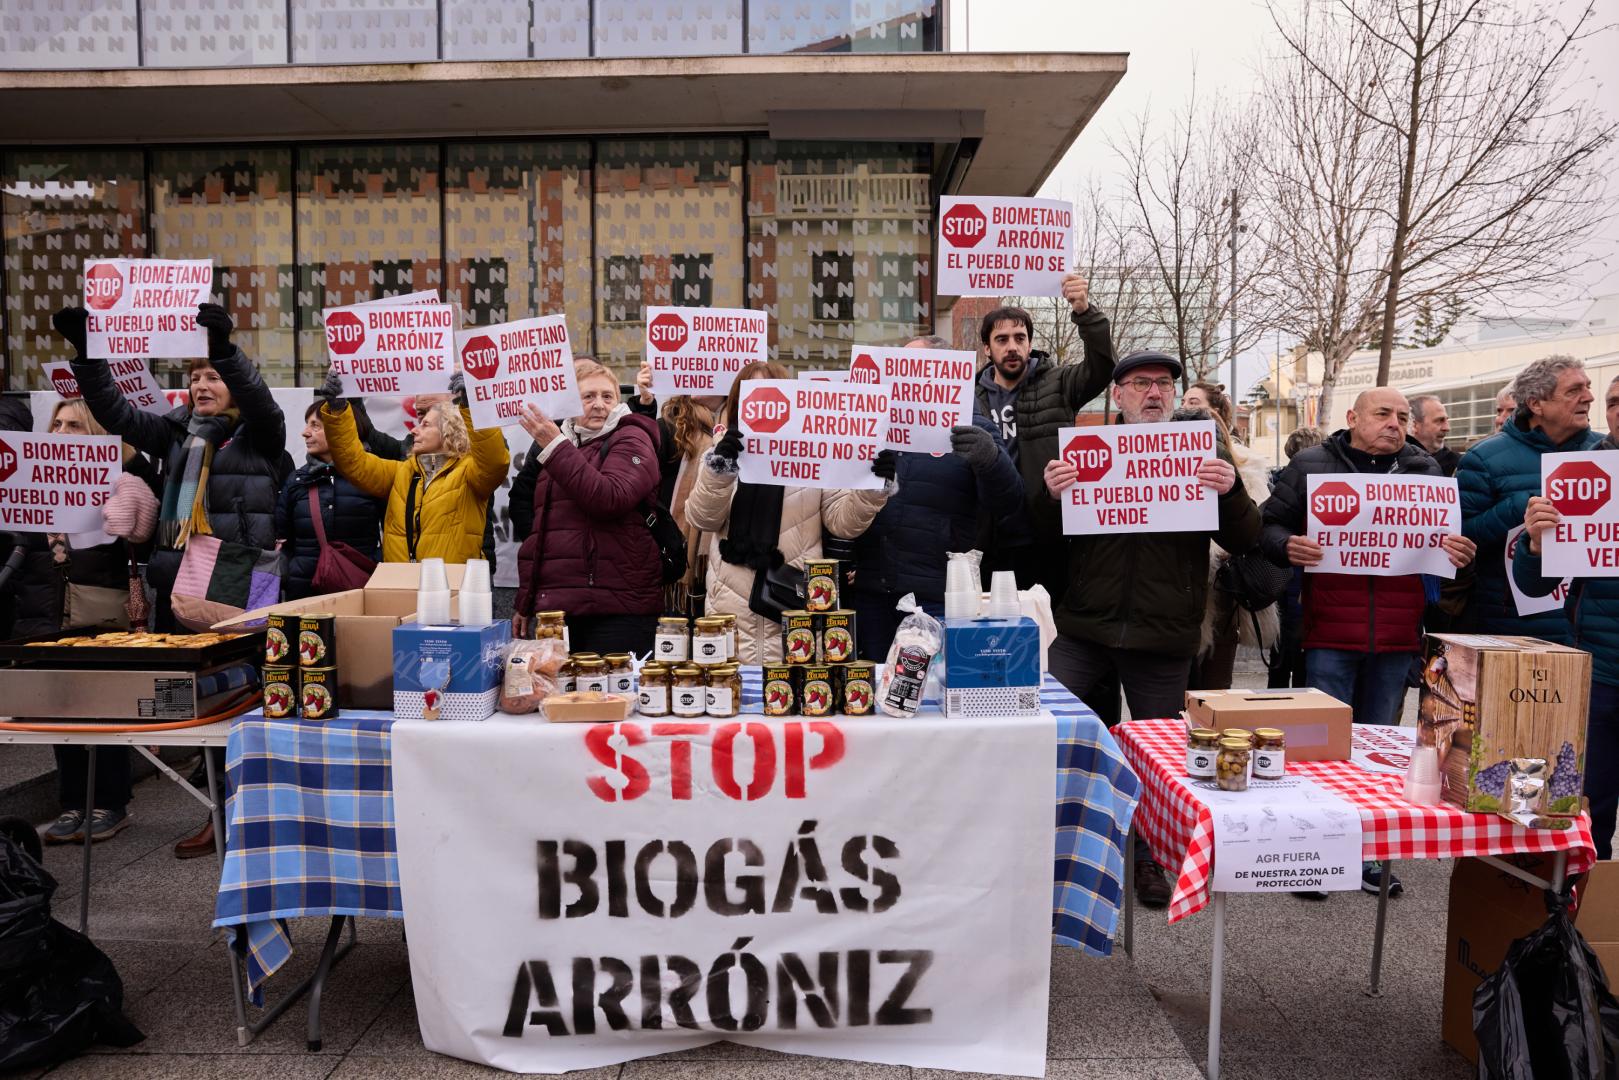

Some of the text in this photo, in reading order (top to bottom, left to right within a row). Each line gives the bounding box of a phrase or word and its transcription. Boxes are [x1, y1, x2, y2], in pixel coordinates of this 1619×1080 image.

[946, 217, 984, 236] STOP
[992, 206, 1071, 228] BIOMETANO
[997, 229, 1065, 250] ARRÓNIZ
[947, 253, 1065, 272] EL PUEBLO NO SE
[129, 265, 211, 285] BIOMETANO
[968, 273, 1014, 289] VENDE
[86, 277, 120, 297] STOP
[133, 286, 200, 308] ARRÓNIZ
[88, 315, 197, 332] EL PUEBLO NO SE
[369, 310, 452, 329] BIOMETANO
[693, 316, 765, 333] BIOMETANO
[327, 324, 362, 342] STOP
[376, 329, 444, 352] ARRÓNIZ
[500, 324, 566, 351] BIOMETANO
[652, 324, 686, 341] STOP
[108, 336, 149, 353] VENDE
[698, 334, 758, 353] ARRÓNIZ
[333, 355, 445, 375] EL PUEBLO NO SE
[465, 347, 496, 369] STOP
[508, 348, 563, 374] ARRÓNIZ
[654, 357, 668, 370] EL
[672, 357, 718, 371] PUEBLO
[723, 358, 739, 372] NO
[852, 367, 878, 384] STOP
[885, 357, 973, 381] BIOMETANO
[55, 378, 78, 393] STOP
[356, 376, 400, 393] VENDE
[475, 374, 567, 401] EL PUEBLO NO SE
[673, 375, 714, 389] VENDE
[796, 390, 888, 413] BIOMETANO
[891, 380, 961, 405] ARRÓNIZ
[495, 400, 523, 418] VENDE
[745, 401, 787, 420] STOP
[890, 408, 960, 428] BLO NO SE
[802, 413, 877, 438] ARRÓNIZ
[886, 428, 911, 444] NDE
[1118, 431, 1213, 454] BIOMETANO
[23, 442, 118, 462] BIOMETANO
[747, 438, 876, 460] EL PUEBLO NO SE
[1066, 449, 1109, 468] STOP
[32, 463, 110, 485] ARRÓNIZ
[771, 460, 820, 480] VENDE
[1125, 454, 1203, 479] ARRÓNIZ
[0, 488, 59, 506] PUEBLO
[65, 491, 86, 506] NO
[1072, 483, 1205, 505] EL PUEBLO NO SE
[1366, 484, 1456, 504] BIOMETANO
[1550, 478, 1607, 500] STOP
[1314, 495, 1357, 513] STOP
[1, 508, 54, 525] VENDE
[1096, 507, 1148, 526] VENDE
[1372, 504, 1449, 527] ARRÓNIZ
[1317, 532, 1448, 548] EL PUEBLO NO SE
[1555, 523, 1619, 542] EL PUE
[1340, 551, 1391, 568] VENDE
[1509, 687, 1563, 703] VINO
[584, 722, 846, 803] STOP
[1256, 852, 1320, 864] AGR FUERA
[536, 819, 902, 920] BIOGÁS
[1235, 867, 1345, 879] DE NUESTRA ZONA DE
[1256, 878, 1322, 888] PROTECCIÓN
[502, 936, 935, 1038] ARRÓNIZ
